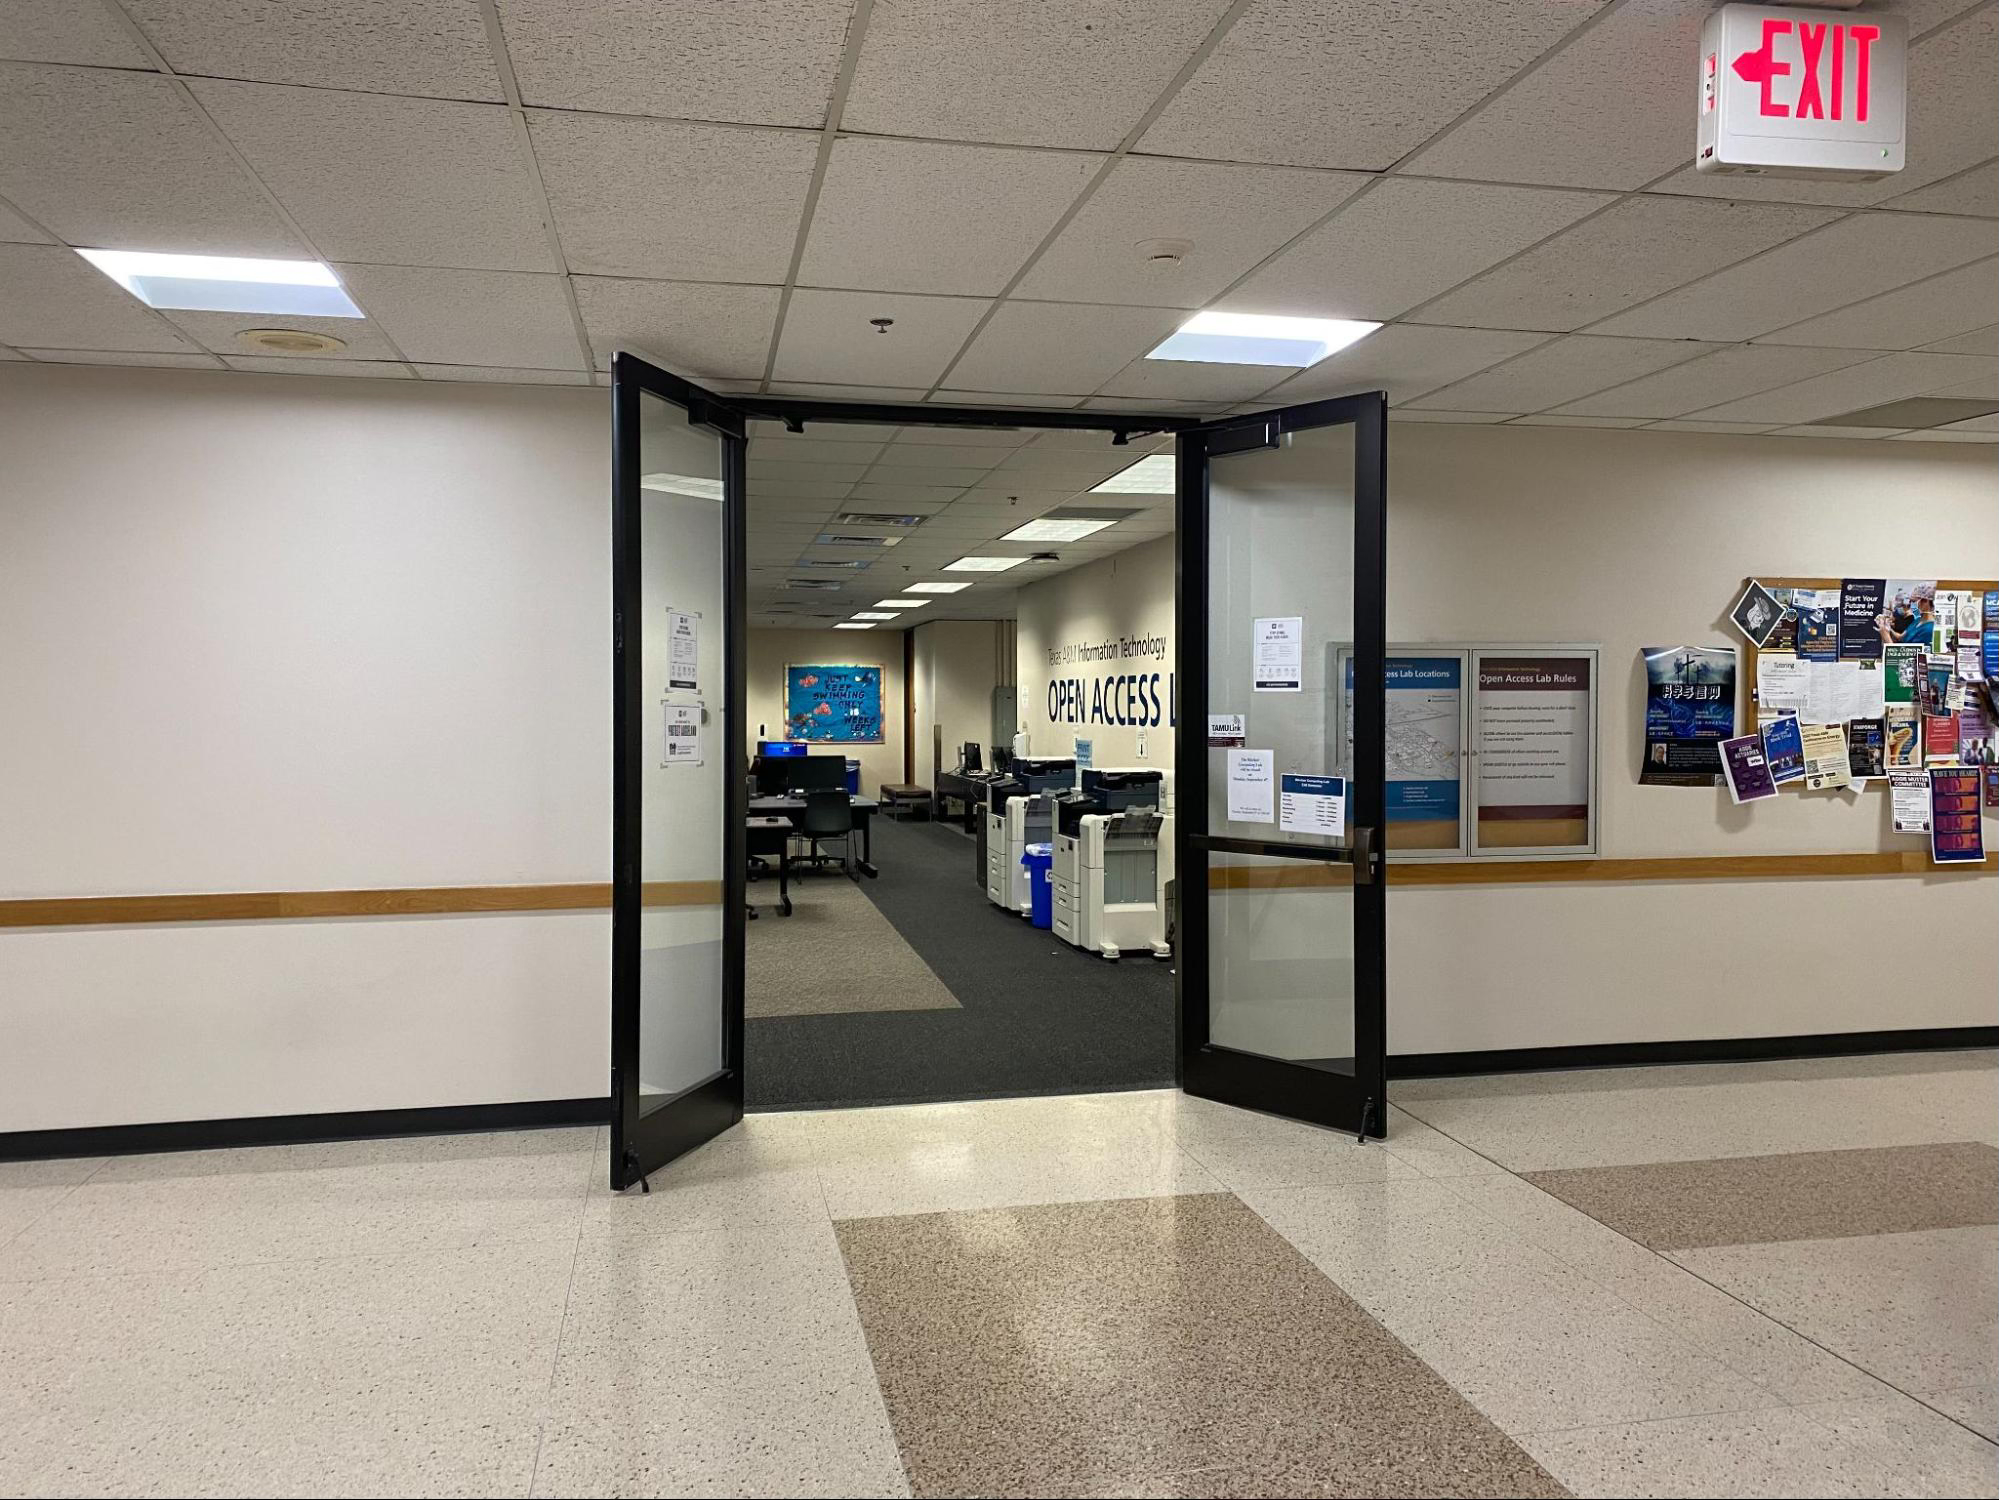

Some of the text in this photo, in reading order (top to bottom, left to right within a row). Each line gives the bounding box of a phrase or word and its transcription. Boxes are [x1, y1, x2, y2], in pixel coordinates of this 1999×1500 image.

[1760, 19, 1880, 122] EXIT
[1048, 632, 1166, 666] Texas A&M Information Technology
[827, 674, 848, 683] JUST
[1400, 670, 1413, 678] Lab
[1415, 670, 1450, 678] Locations
[1479, 674, 1577, 685] Open Access Lab Rules
[825, 683, 852, 692] KEEP
[813, 691, 864, 700] SWIMMING
[1048, 678, 1086, 722] OPEN
[1091, 673, 1161, 727] ACCESS
[839, 700, 864, 709] ONLY
[844, 715, 876, 724] WEEKS
[850, 723, 872, 732] LEFT
